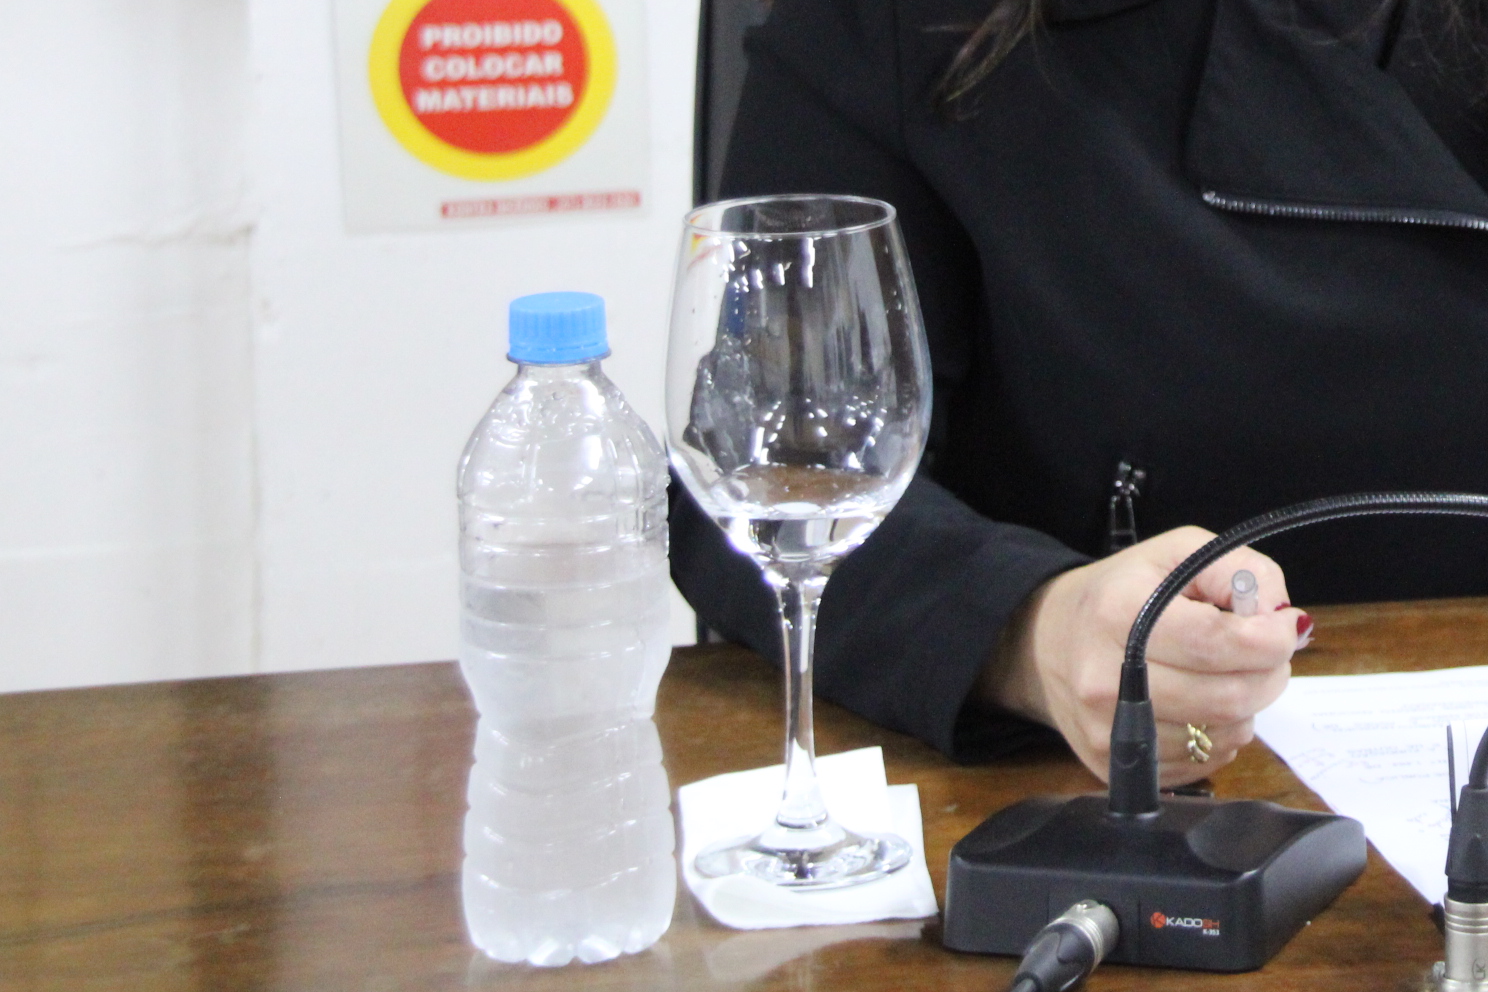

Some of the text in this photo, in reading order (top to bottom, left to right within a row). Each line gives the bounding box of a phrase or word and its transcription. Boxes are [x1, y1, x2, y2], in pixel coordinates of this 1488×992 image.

[420, 19, 564, 50] PROIBIDO
[423, 53, 564, 81] COLOCAR
[415, 83, 575, 113] MATERIAIS
[1165, 916, 1220, 928] KADOSH
